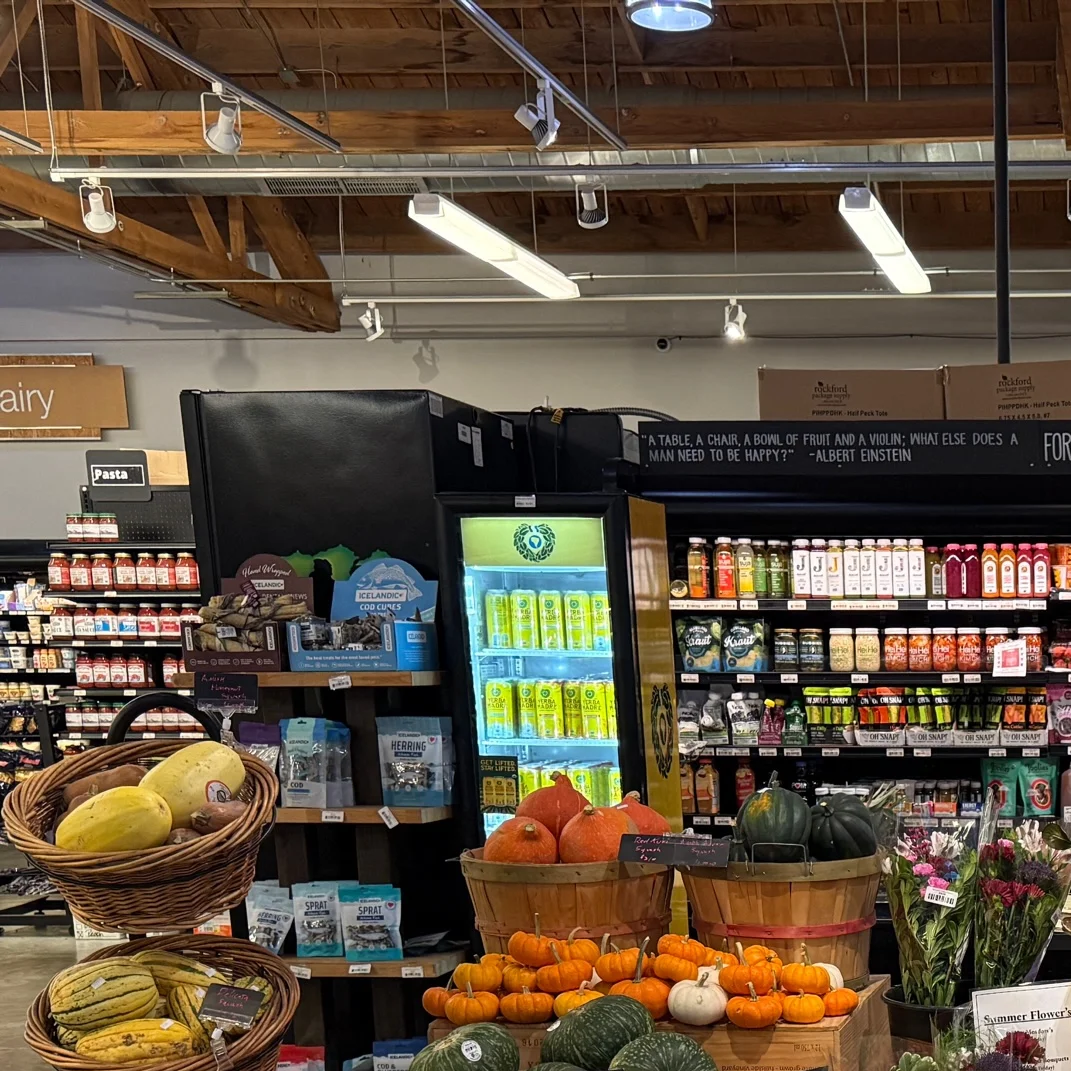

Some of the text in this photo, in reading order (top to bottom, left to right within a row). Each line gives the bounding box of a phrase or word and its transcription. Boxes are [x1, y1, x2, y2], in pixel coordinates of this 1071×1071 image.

[999, 376, 1032, 387] rockford
[814, 383, 847, 393] rockford
[658, 433, 693, 447] TABLE,
[696, 433, 704, 446] A
[708, 433, 742, 447] CHAIR,
[744, 433, 752, 446] A
[753, 433, 784, 446] BOWL
[786, 433, 799, 446] OF
[804, 433, 830, 446] FRUIT
[834, 433, 856, 446] AND
[858, 433, 866, 446] A
[869, 433, 906, 447] VIOLIN;
[910, 432, 940, 446] WHAT
[942, 432, 966, 446] ELSE
[972, 432, 1003, 446] DOES
[1010, 432, 1019, 446] A
[1043, 432, 1071, 462] FOR
[649, 448, 912, 463] MAN NEED TO BE HAPPY?" -ALBERT EINSTEIN
[94, 469, 128, 480] Pasta
[724, 635, 755, 648] Kraut
[391, 740, 426, 752] HERRING
[305, 901, 328, 910] SPRAT
[358, 906, 382, 914] SPRAT
[984, 1007, 1071, 1024] Summer Flower's
